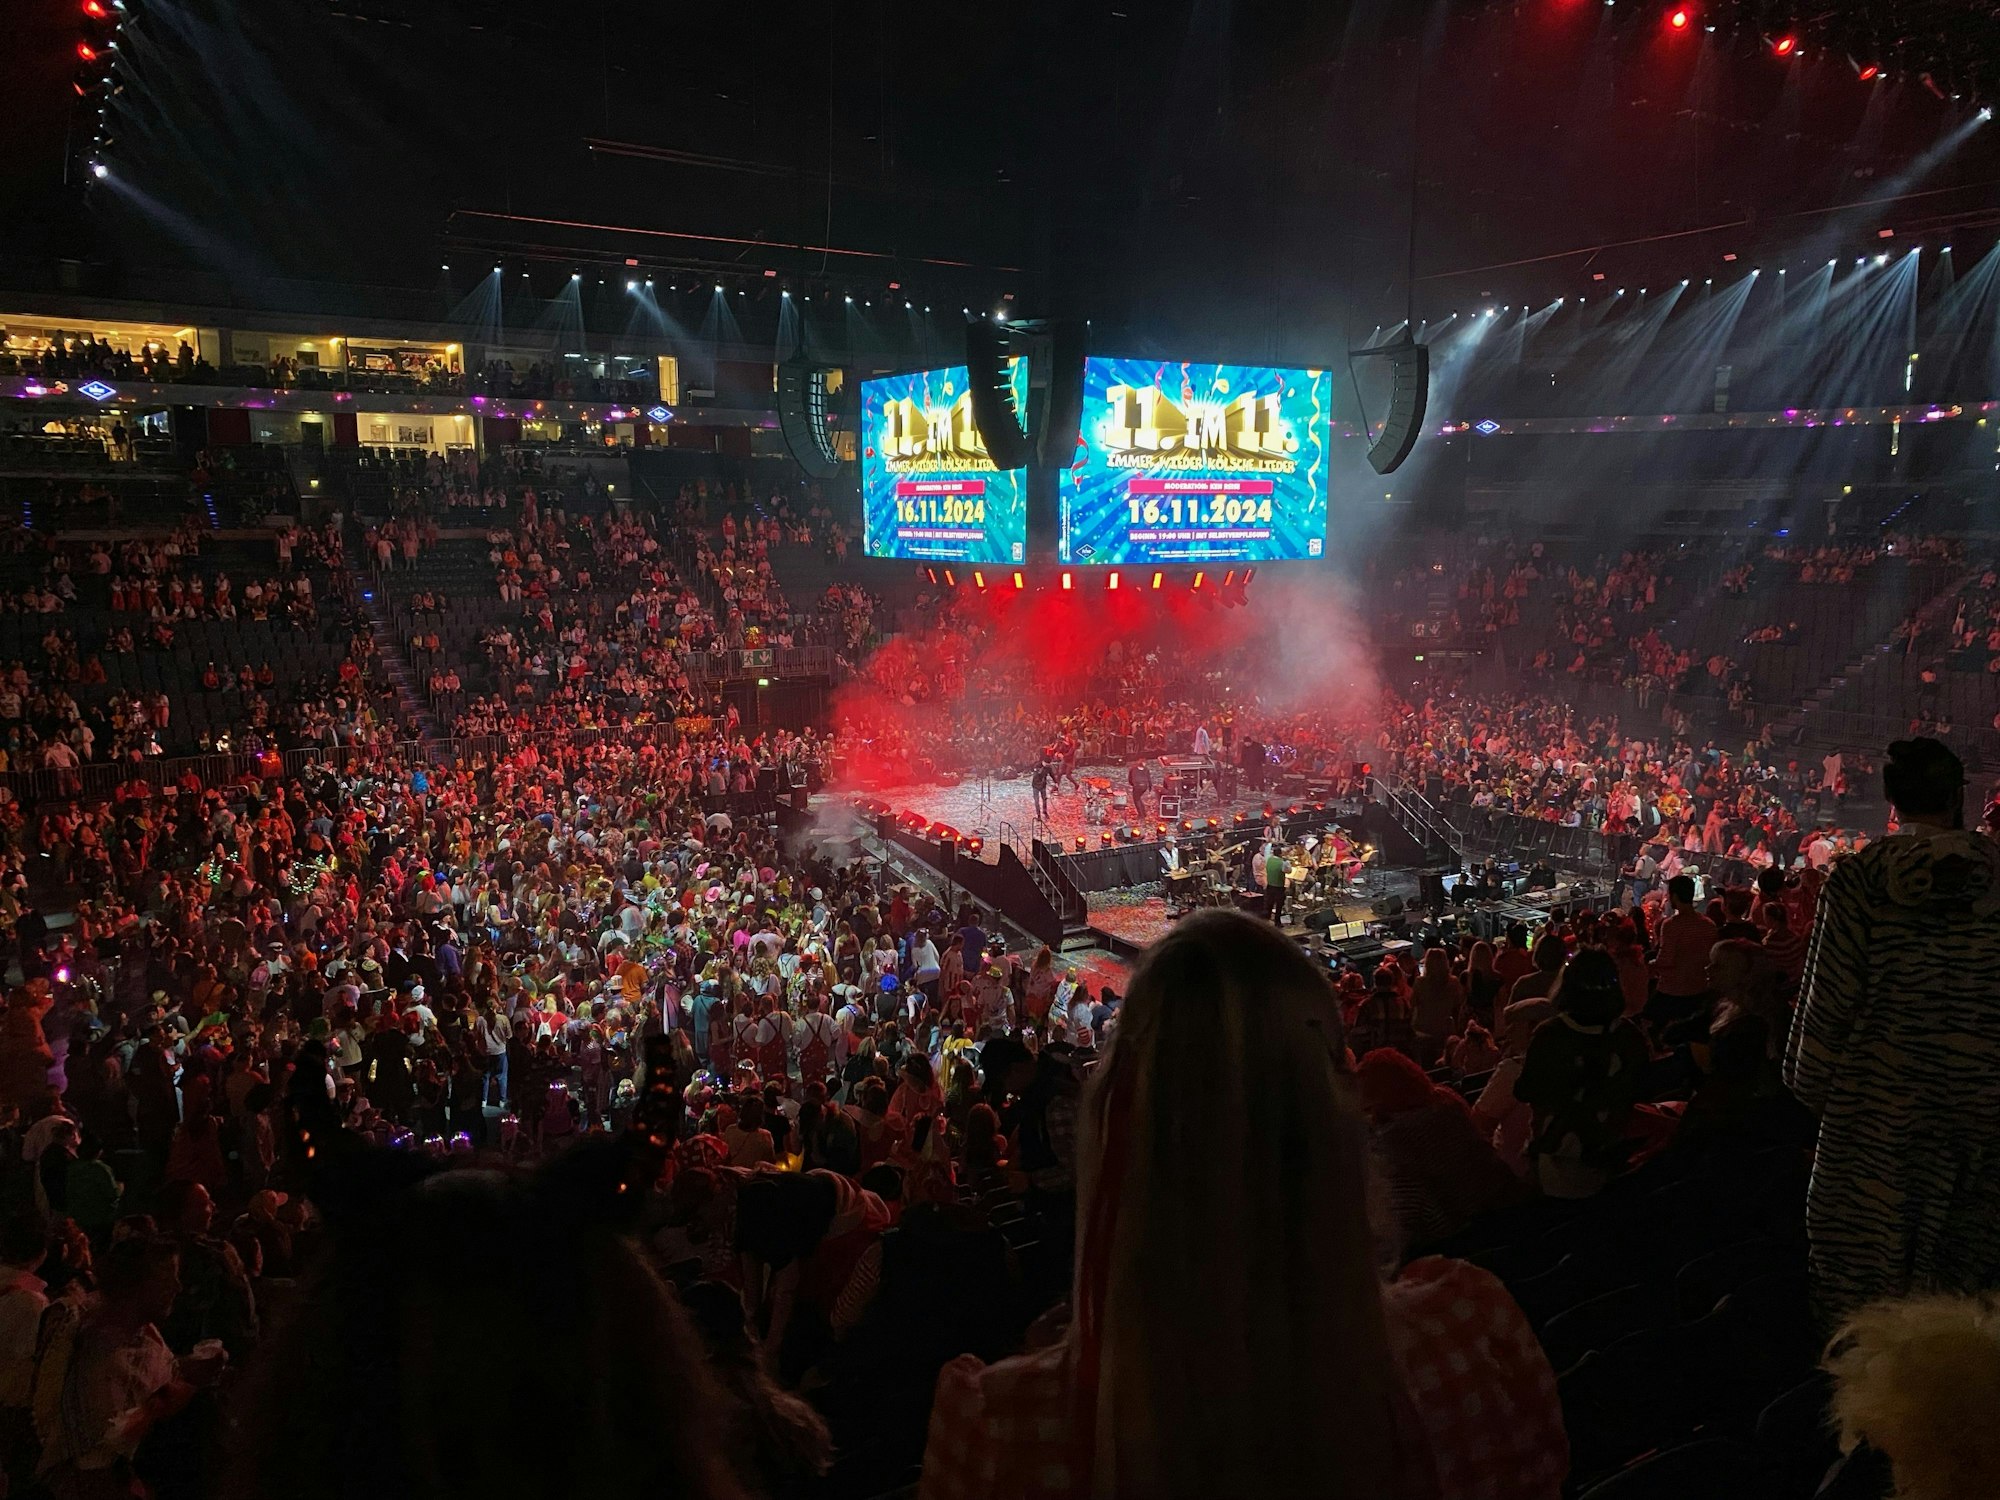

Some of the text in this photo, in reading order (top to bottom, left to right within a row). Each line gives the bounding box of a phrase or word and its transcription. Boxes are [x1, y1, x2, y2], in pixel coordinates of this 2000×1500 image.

[1106, 385, 1176, 450] 11.
[1182, 407, 1228, 451] IM
[926, 409, 954, 453] IM
[1106, 454, 1297, 475] IMMER WIEDER KÖLSCHE LIEDER
[896, 499, 985, 524] 16.11.2024
[1128, 499, 1273, 524] 16.11.2024
